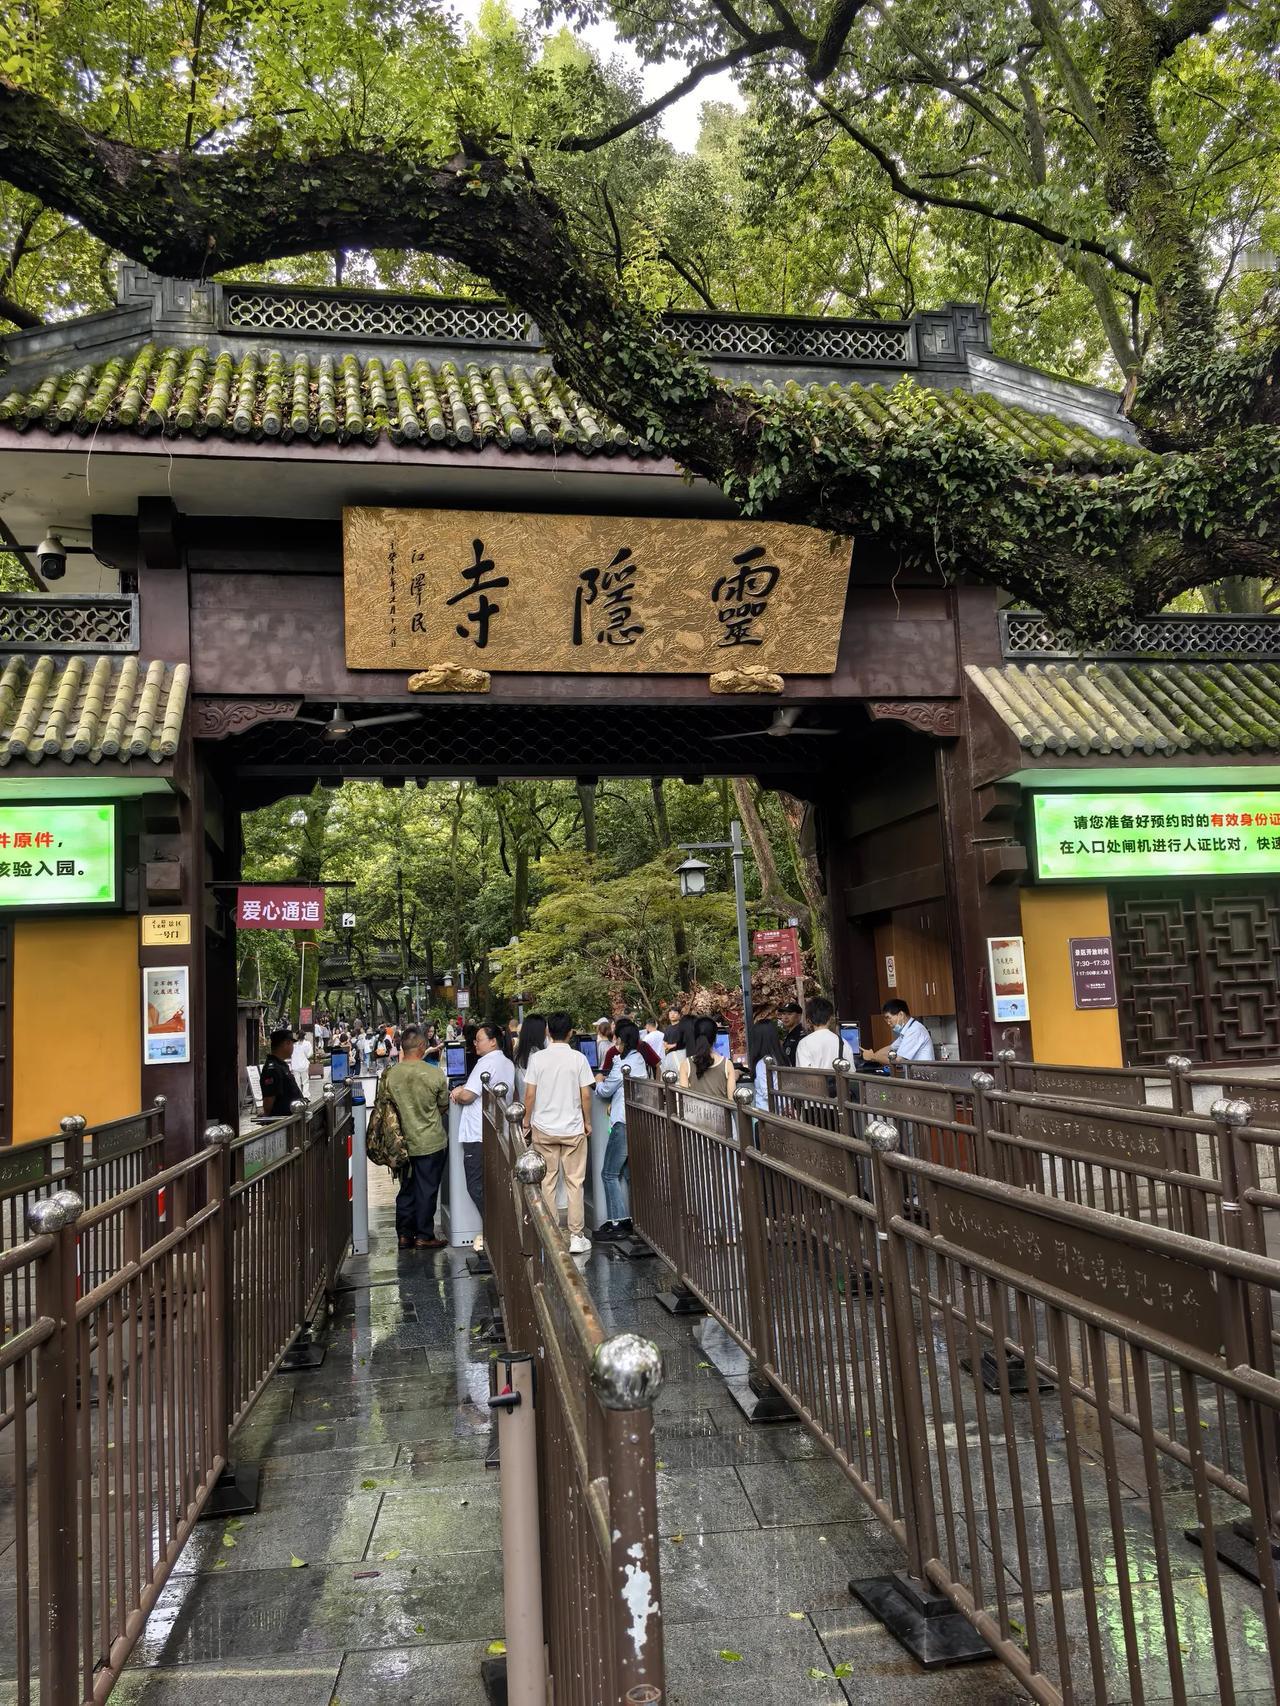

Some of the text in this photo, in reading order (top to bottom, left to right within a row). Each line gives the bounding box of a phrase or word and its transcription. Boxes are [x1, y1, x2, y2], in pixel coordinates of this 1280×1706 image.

[1073, 813, 1280, 829] 请您准备好预约时的有效身份证
[242, 900, 320, 921] 爱心通道
